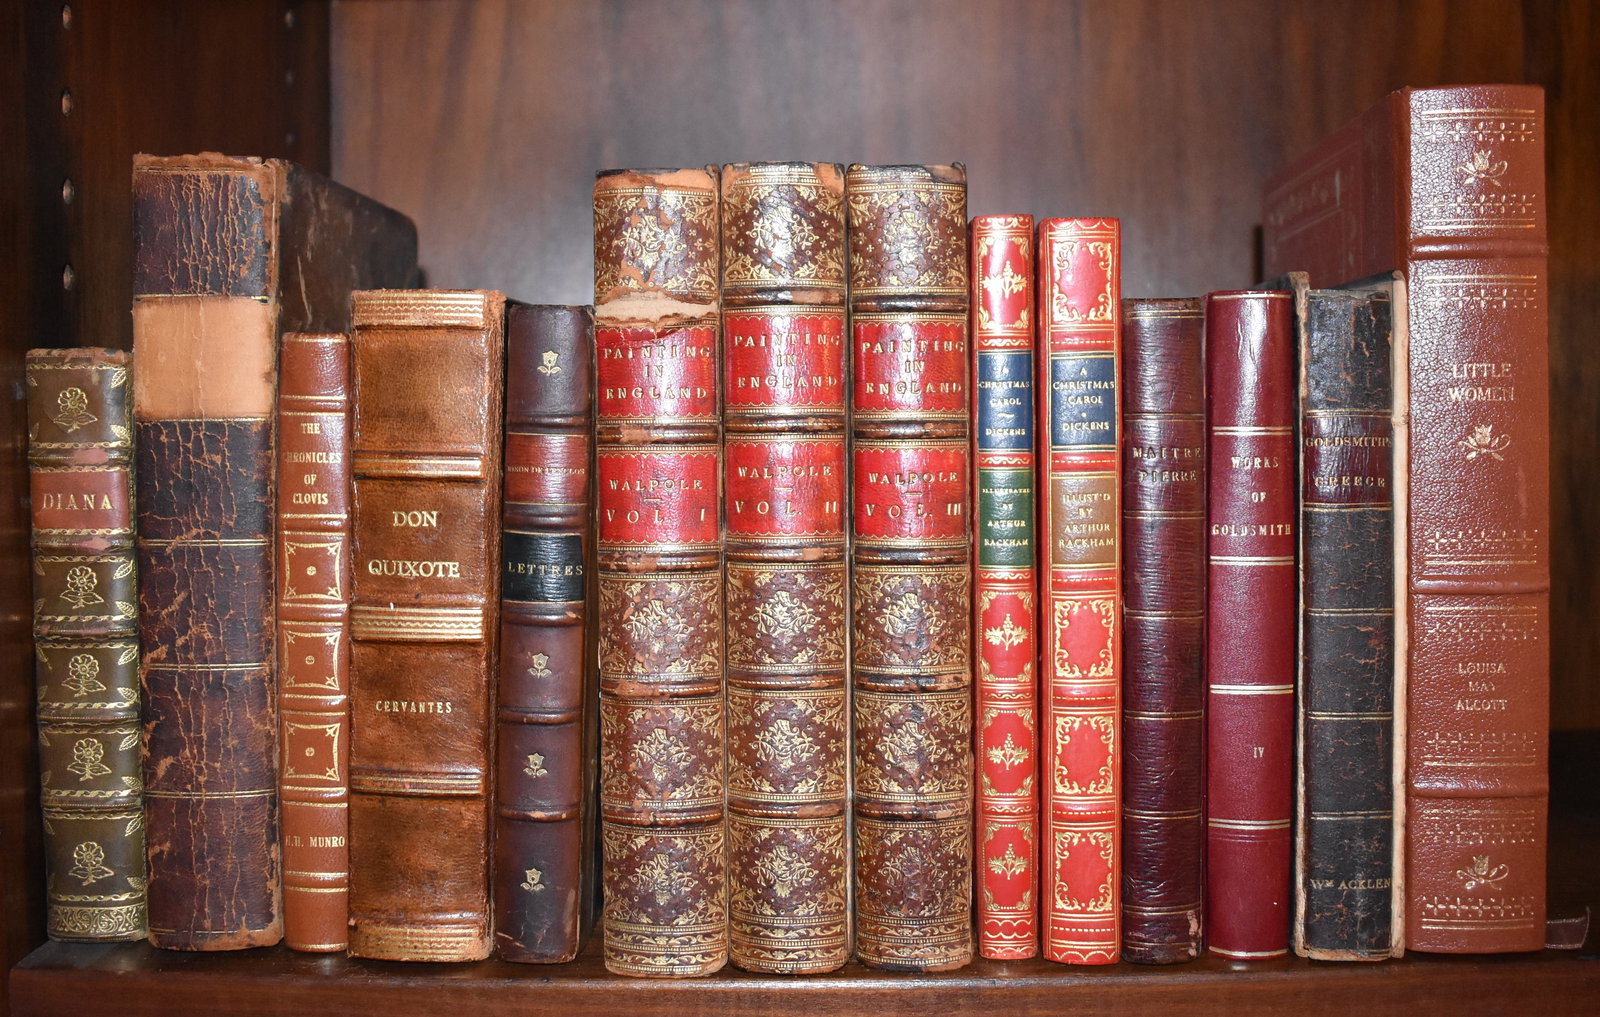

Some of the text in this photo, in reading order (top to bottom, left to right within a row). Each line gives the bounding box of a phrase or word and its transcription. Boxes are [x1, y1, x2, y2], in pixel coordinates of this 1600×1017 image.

[734, 333, 841, 347] PAINTING
[604, 345, 711, 359] PAINTING
[861, 340, 965, 354] PAINTING
[776, 354, 797, 367] IN
[904, 360, 925, 373] IN
[644, 364, 663, 377] IN
[1080, 367, 1088, 376] A
[1452, 363, 1512, 378] LITTLE
[737, 375, 838, 390] ENGLAND
[865, 381, 962, 395] ENGLAND
[979, 381, 1030, 389] CHRISTMAS
[1053, 381, 1115, 390] CHRISTMAS
[606, 387, 707, 399] ENGLAND
[1447, 386, 1515, 401] WOMEN
[990, 398, 1022, 406] CAROL
[1068, 395, 1103, 405] CAROL
[300, 422, 320, 434] THE
[985, 428, 1026, 436] DICKENS
[1062, 422, 1110, 431] DICKENS
[1133, 447, 1201, 458] MAITRE
[1231, 456, 1279, 470] WORKS
[738, 465, 832, 478] WALPOLE
[868, 471, 958, 484] WALPOLE
[1139, 470, 1197, 482] PIERRE
[303, 473, 317, 485] OF
[609, 479, 703, 491] WALPOLE
[1315, 476, 1385, 487] GREECE
[42, 493, 113, 511] DIANA
[292, 493, 329, 504] CLOVIS
[1251, 491, 1267, 503] OF
[824, 500, 838, 514] II
[1079, 507, 1093, 516] BY
[392, 510, 437, 527] DON
[699, 508, 705, 521] I
[1064, 523, 1110, 533] ARTHUR
[1212, 524, 1291, 536] GOLDSMITH
[984, 538, 1029, 546] RACKHAM
[1058, 538, 1114, 548] RACKHAM
[367, 560, 460, 578] QUIXOTE
[508, 561, 583, 576] LETTRES
[1458, 662, 1507, 674] LOUISA
[376, 701, 453, 713] CERVANTES
[1456, 699, 1508, 710] ALCOTT
[1252, 747, 1264, 758] IV
[309, 836, 345, 847] MUNRO
[1338, 878, 1391, 889] ACKLEN
